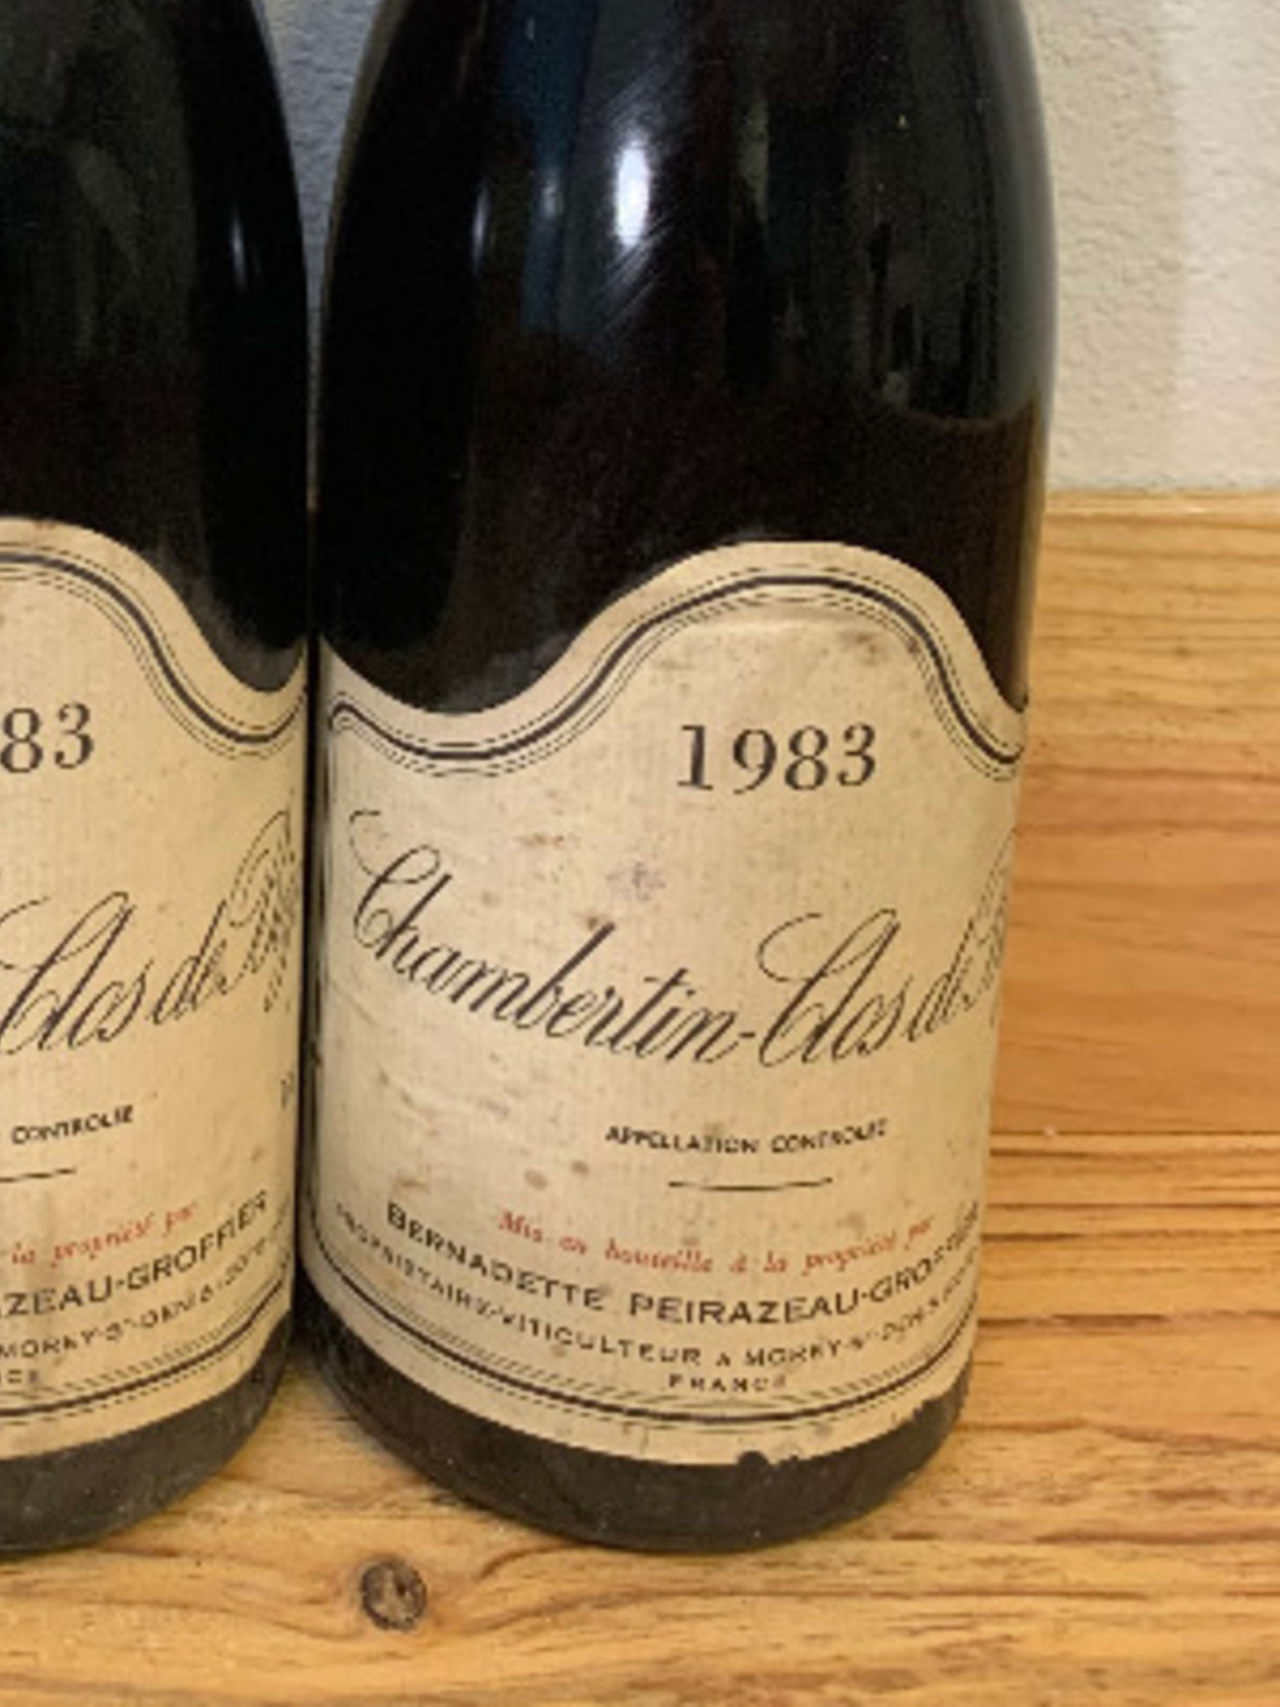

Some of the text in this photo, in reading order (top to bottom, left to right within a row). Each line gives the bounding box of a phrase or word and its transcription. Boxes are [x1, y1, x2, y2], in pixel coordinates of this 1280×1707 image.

[677, 722, 877, 795] 1983
[604, 1125, 759, 1154] APPELLATION
[386, 1199, 605, 1311] BERNADETTE
[497, 1210, 544, 1244] Mis
[604, 1237, 714, 1273] bouteille
[763, 1248, 788, 1274] la
